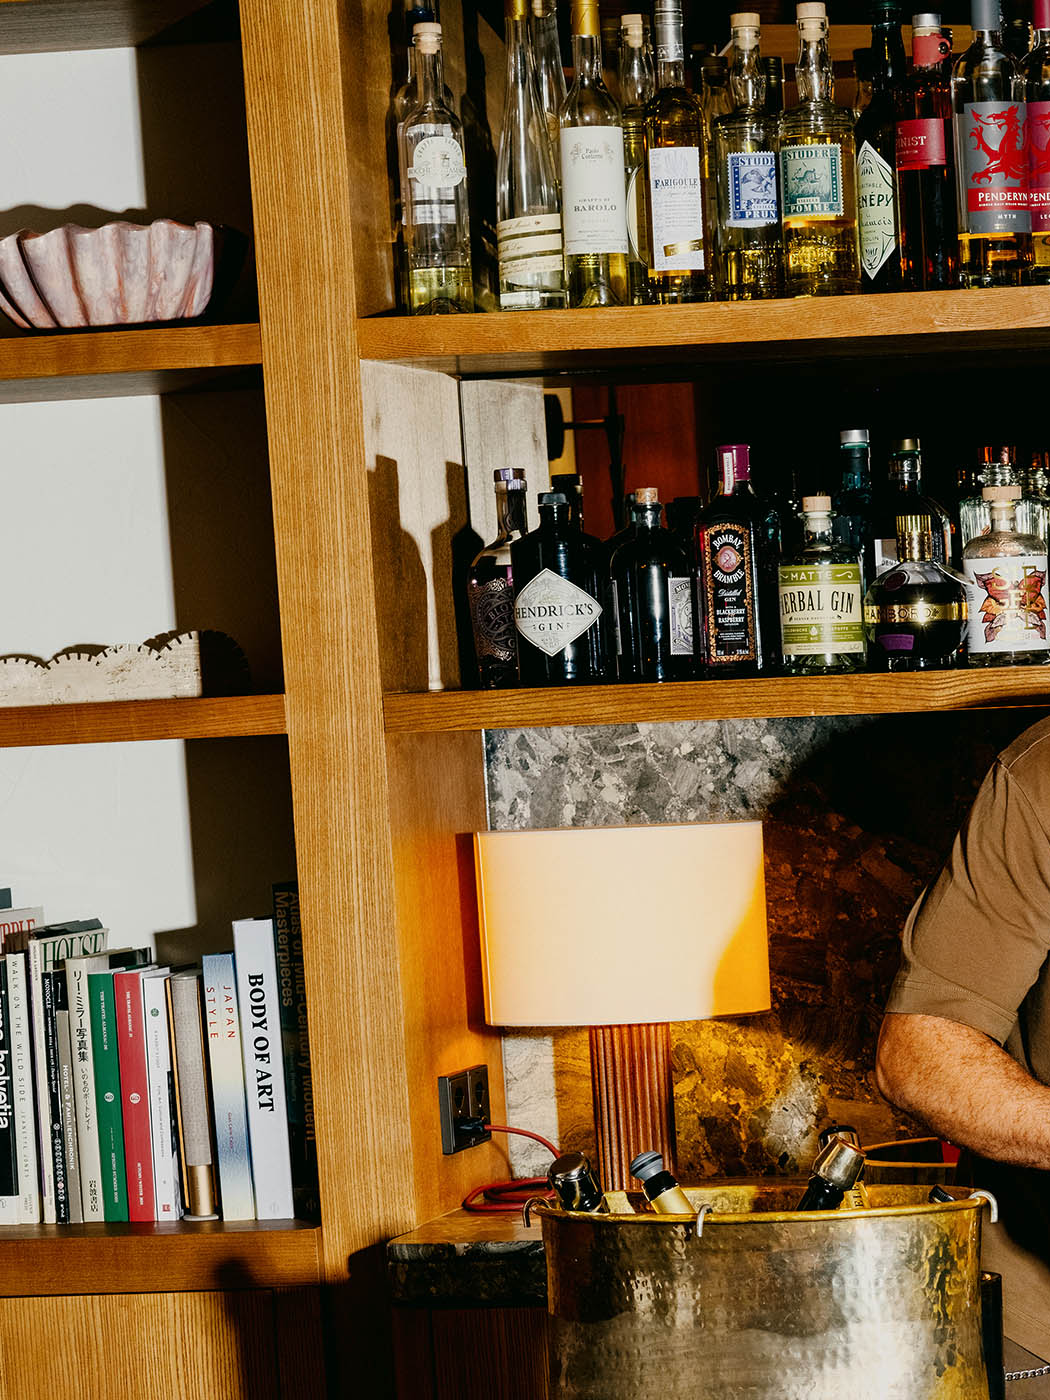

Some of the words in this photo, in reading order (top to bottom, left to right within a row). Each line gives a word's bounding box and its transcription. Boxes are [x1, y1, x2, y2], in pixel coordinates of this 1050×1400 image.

[787, 149, 830, 160] STUDER
[654, 177, 699, 190] FARIGOULE
[978, 192, 1028, 202] PENDERYN
[574, 204, 617, 213] BAROLO
[790, 203, 831, 213] POMME
[712, 533, 744, 551] BOMBAY
[713, 568, 745, 584] BRAMBLE
[791, 570, 833, 580] MATTE
[831, 589, 855, 615] GIN
[516, 603, 594, 620] HENDRICK'S
[716, 608, 746, 616] BLACKBERRY
[718, 616, 744, 624] RASPBERRY
[538, 622, 564, 632] GIN
[274, 891, 293, 1007] Masterpieces
[14, 995, 20, 1009] ON
[44, 978, 52, 1009] MONOCLE
[247, 973, 268, 1031] BODY
[73, 970, 89, 1062] リー・ミラー写真集
[206, 986, 218, 1039] STYLE
[223, 985, 236, 1039] JAPAN
[16, 1043, 24, 1070] WILD
[252, 1036, 270, 1065] OF
[18, 1077, 26, 1104] SIDE
[256, 1068, 275, 1113] ART
[65, 1101, 75, 1171] FAMILIENCHRONIK
